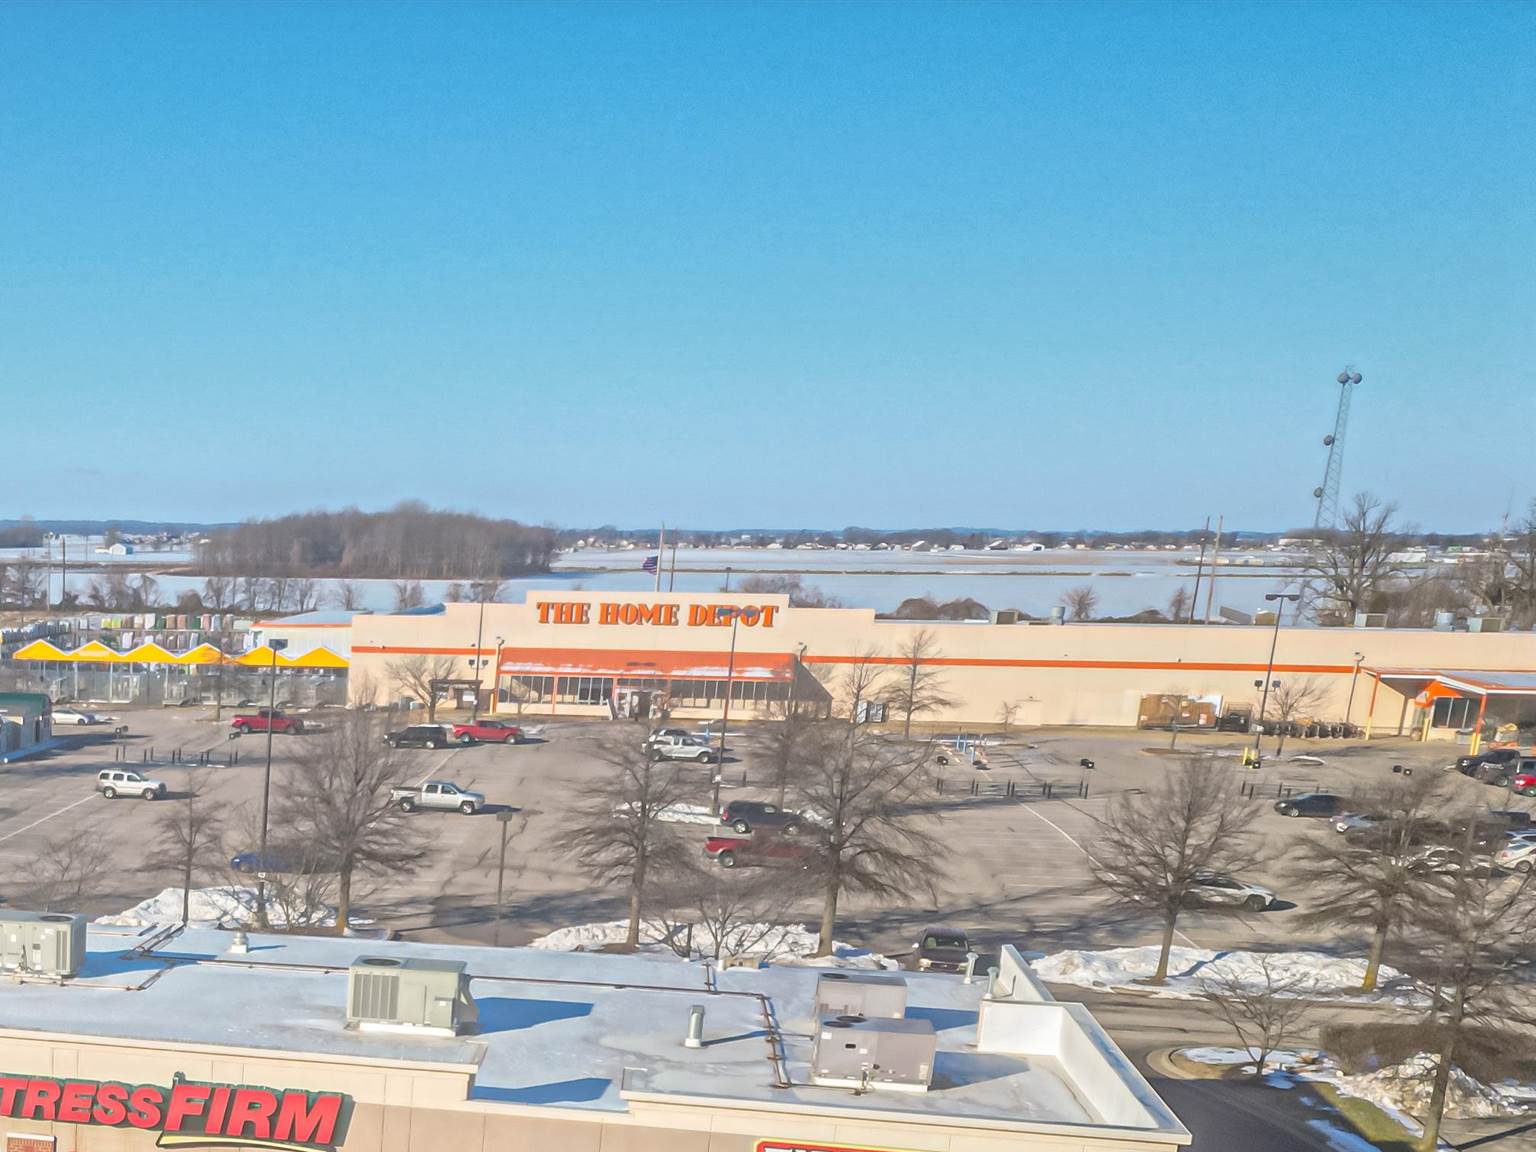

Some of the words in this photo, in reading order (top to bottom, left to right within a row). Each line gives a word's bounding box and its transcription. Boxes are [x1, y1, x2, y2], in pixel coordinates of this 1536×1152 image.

[536, 602, 591, 625] THE
[598, 602, 680, 627] HOME
[687, 604, 779, 628] DEPOT
